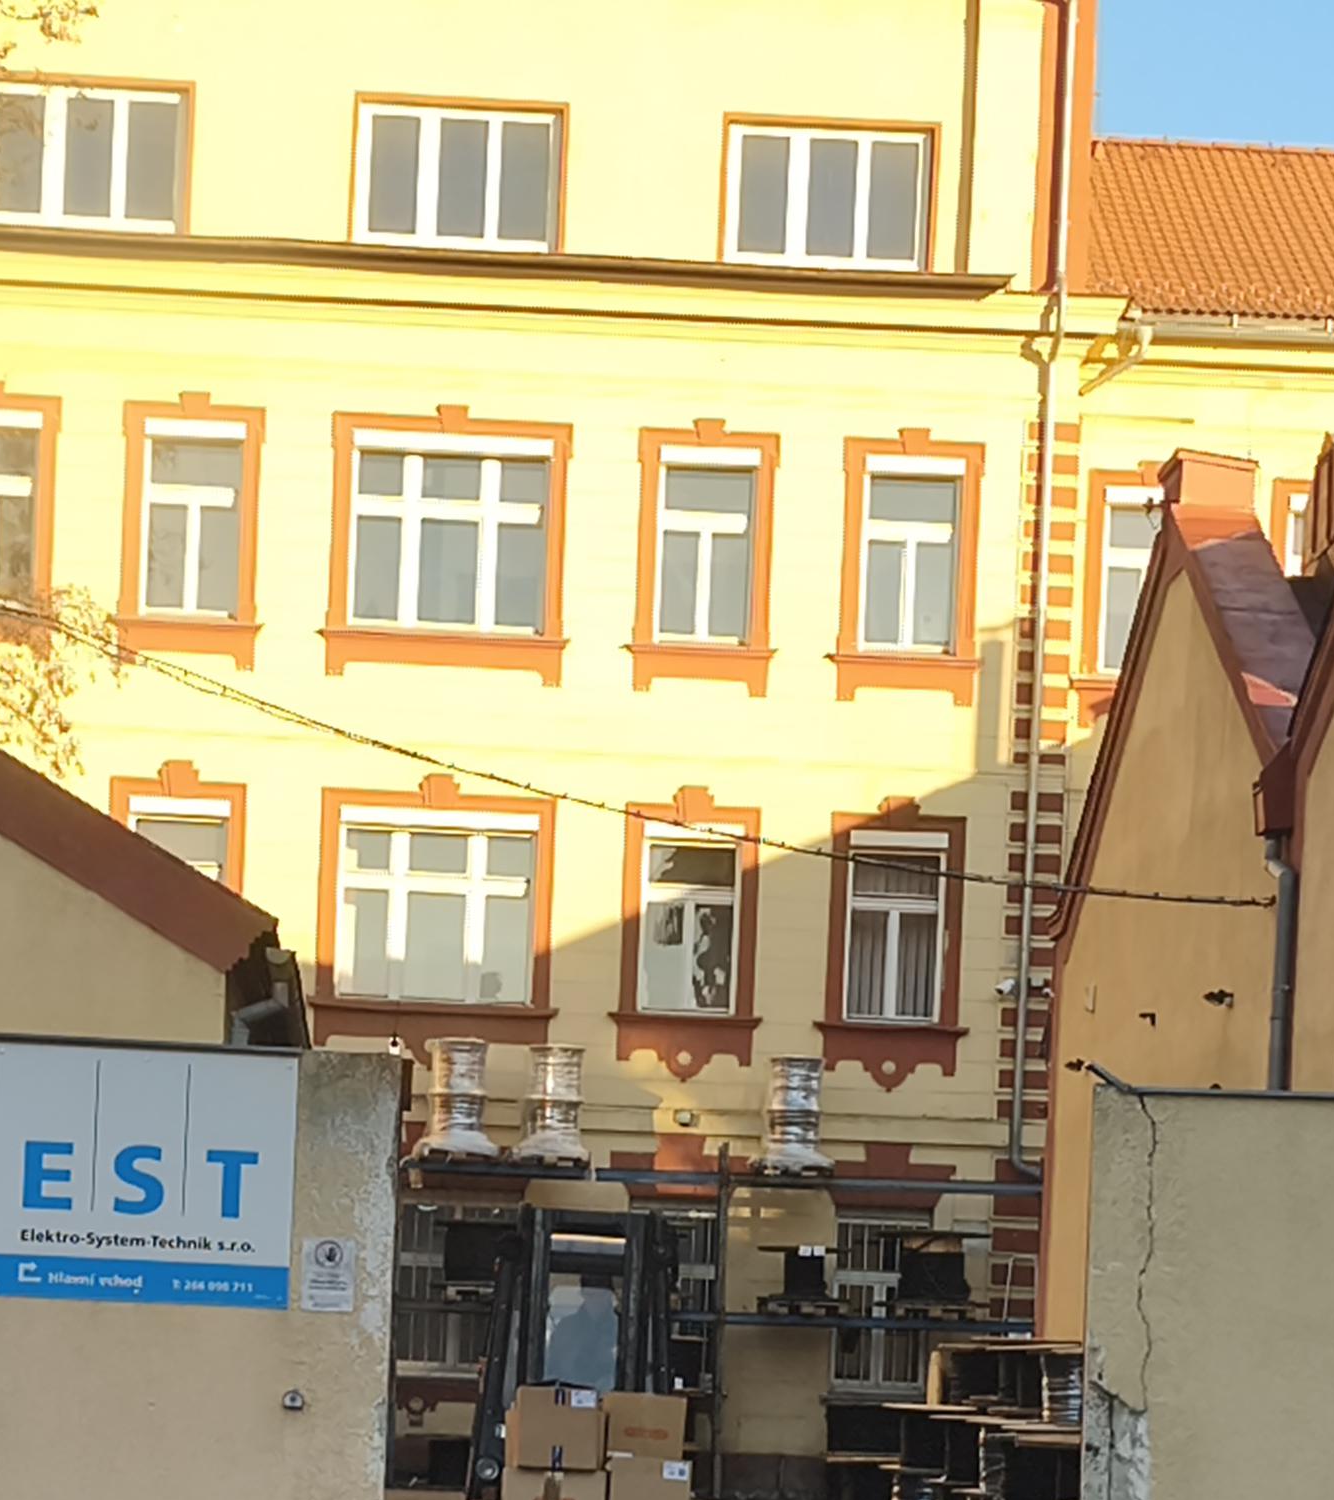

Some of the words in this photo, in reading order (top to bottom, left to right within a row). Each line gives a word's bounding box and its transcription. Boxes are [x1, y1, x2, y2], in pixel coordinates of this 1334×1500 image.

[20, 1228, 212, 1252] Elektro-System-Technik
[217, 1239, 256, 1253] s.r.o.
[98, 1273, 143, 1289] vchod
